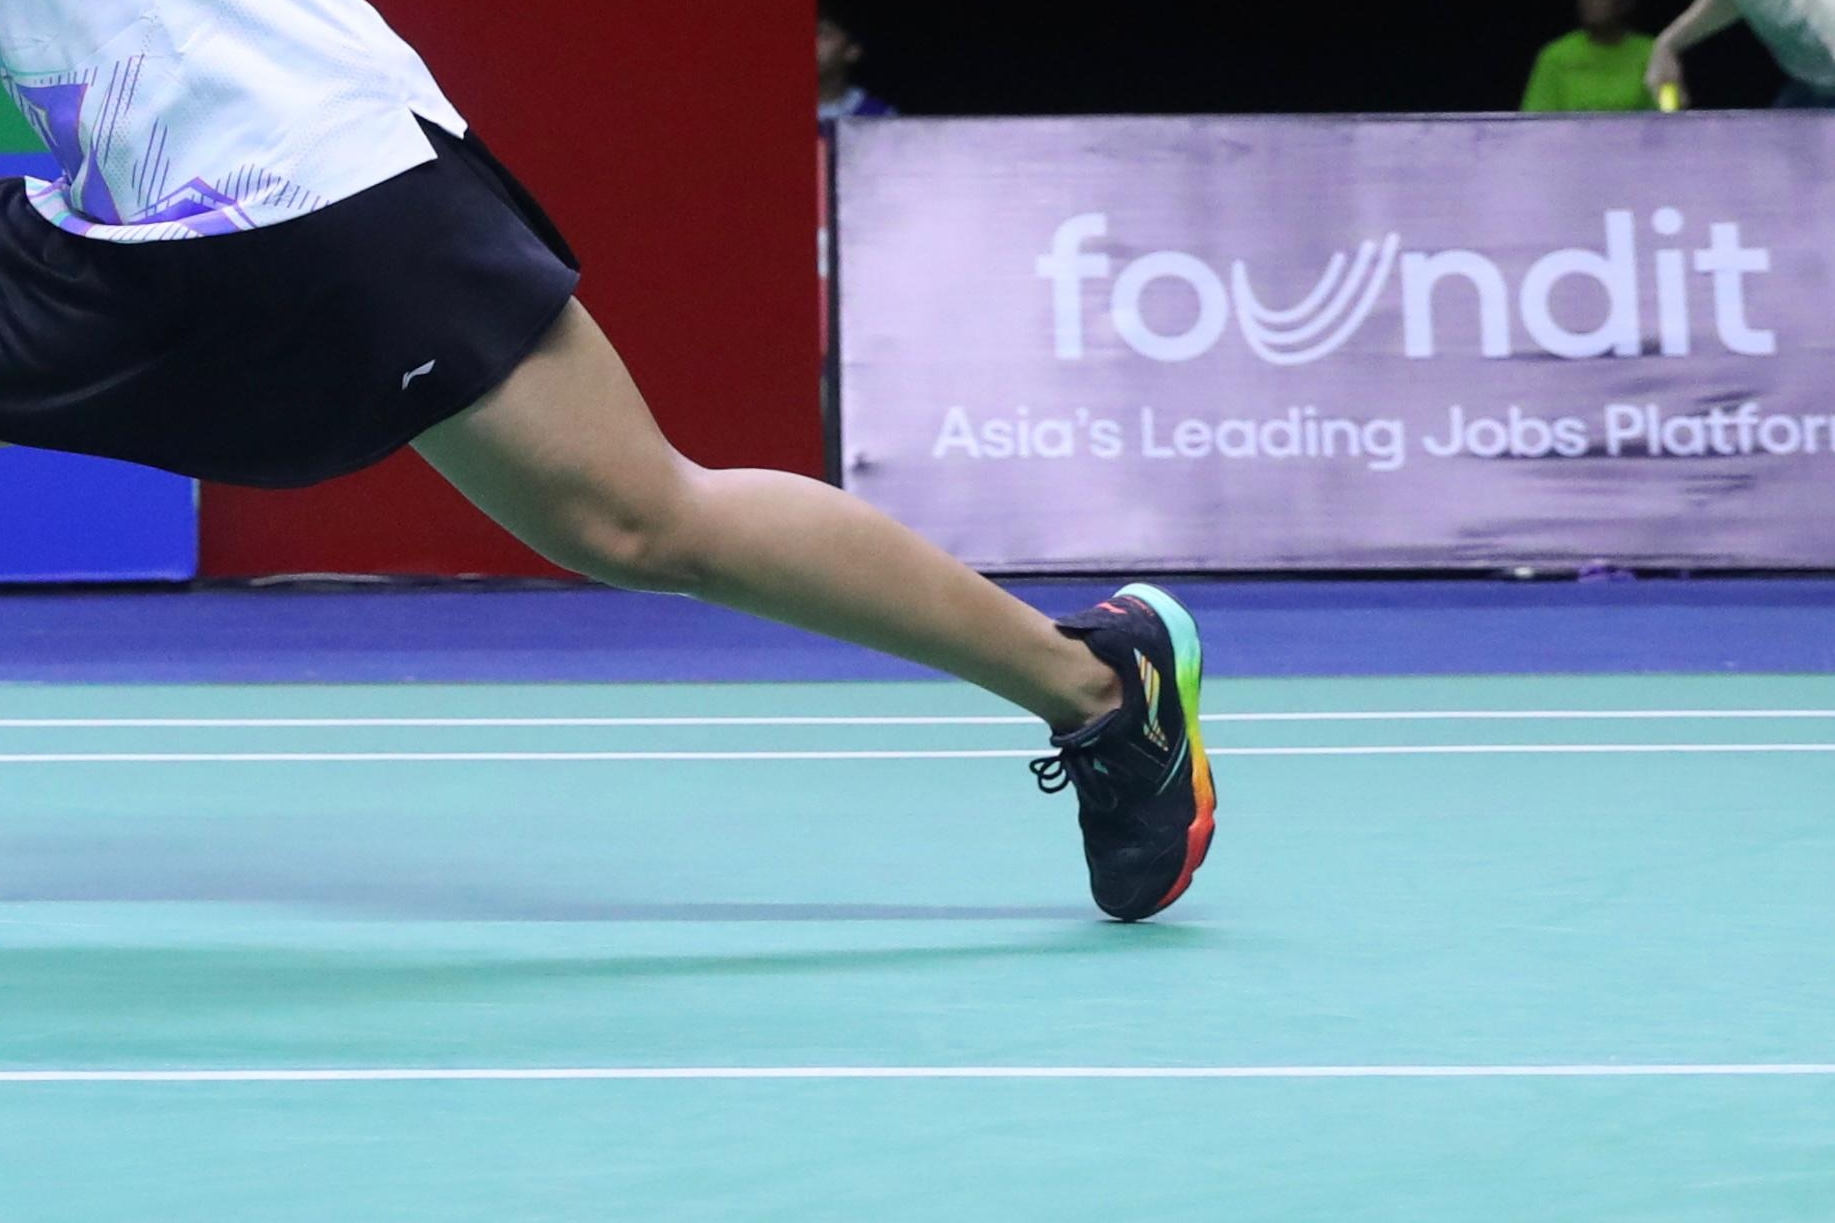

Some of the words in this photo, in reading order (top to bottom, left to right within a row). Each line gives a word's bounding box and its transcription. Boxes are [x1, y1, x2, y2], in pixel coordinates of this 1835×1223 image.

[1036, 208, 1778, 366] foundit
[932, 406, 1123, 460] Asia's
[1140, 406, 1406, 471] Leading
[1422, 405, 1590, 458] Jobs
[1605, 402, 1835, 457] Platfor
